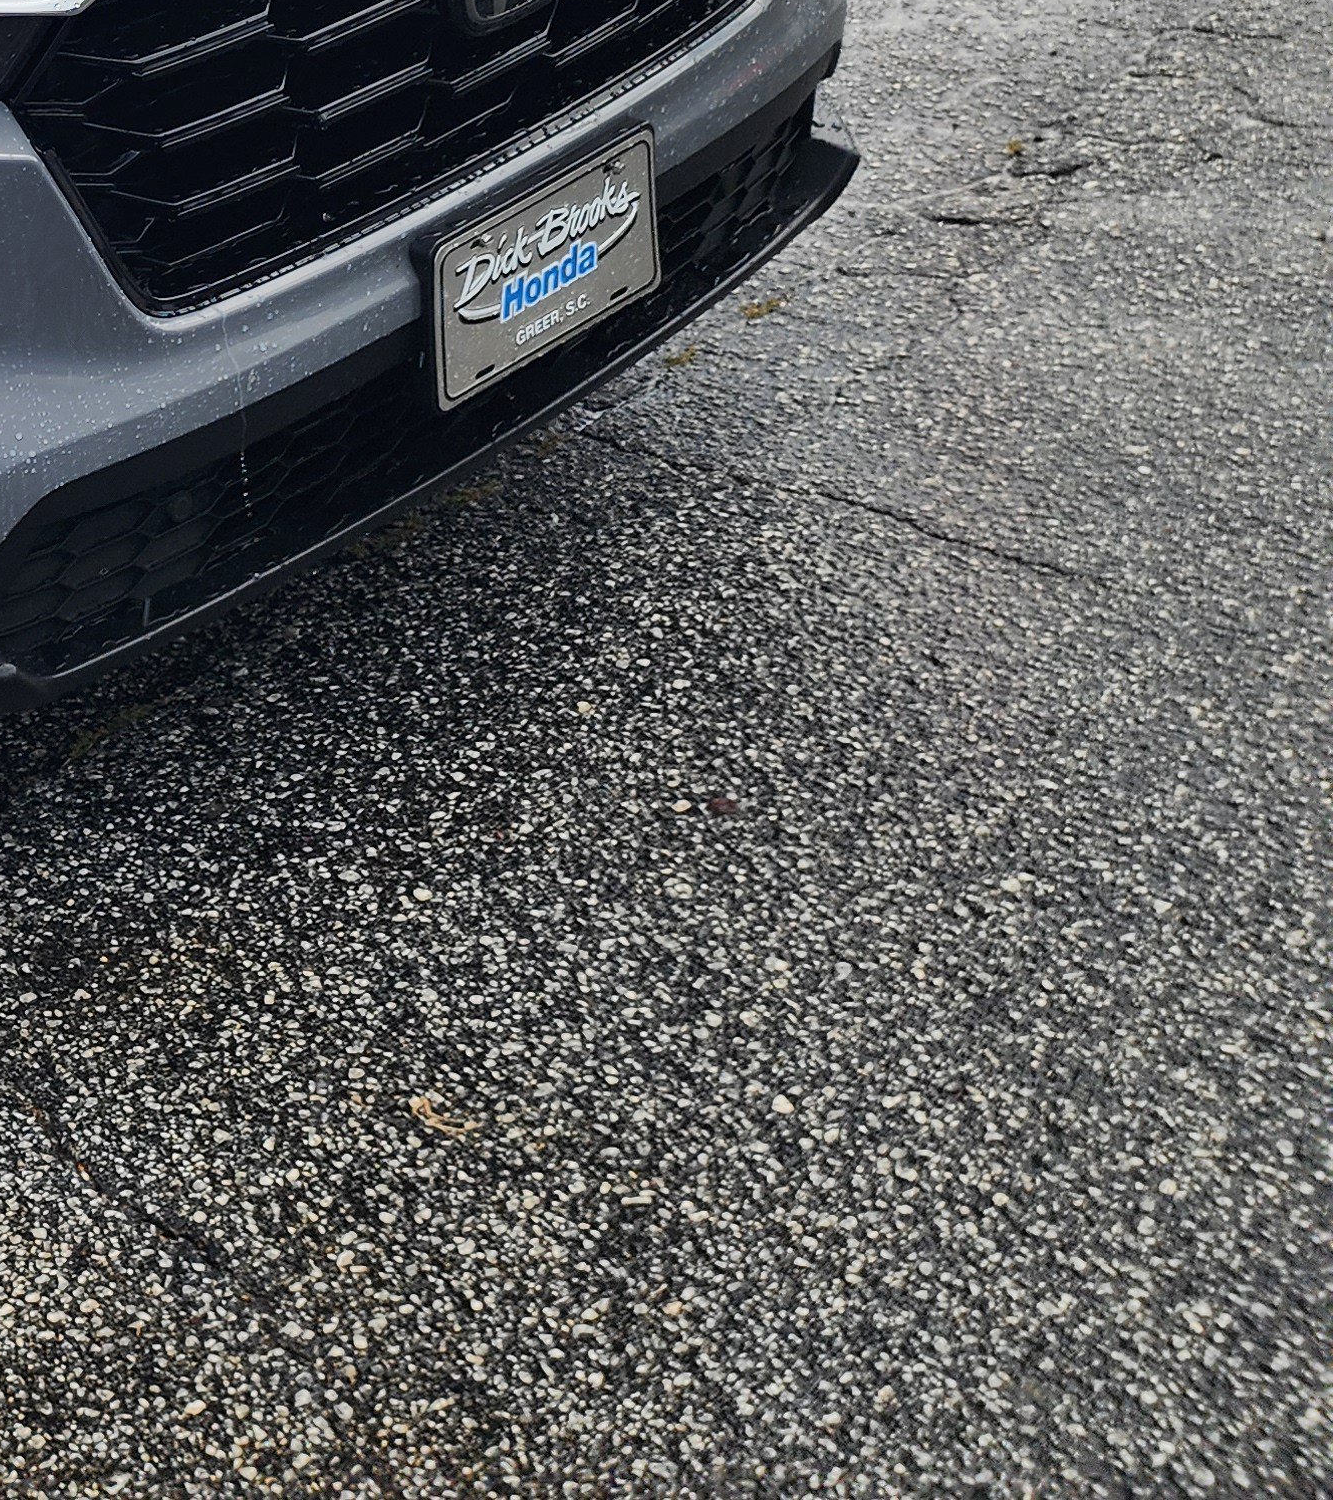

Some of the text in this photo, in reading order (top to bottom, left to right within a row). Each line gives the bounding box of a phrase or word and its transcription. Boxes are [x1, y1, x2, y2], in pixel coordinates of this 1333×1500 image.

[453, 178, 640, 311] Dick Brooks
[500, 240, 598, 323] Honda
[516, 293, 591, 346] GREER, S.C.
